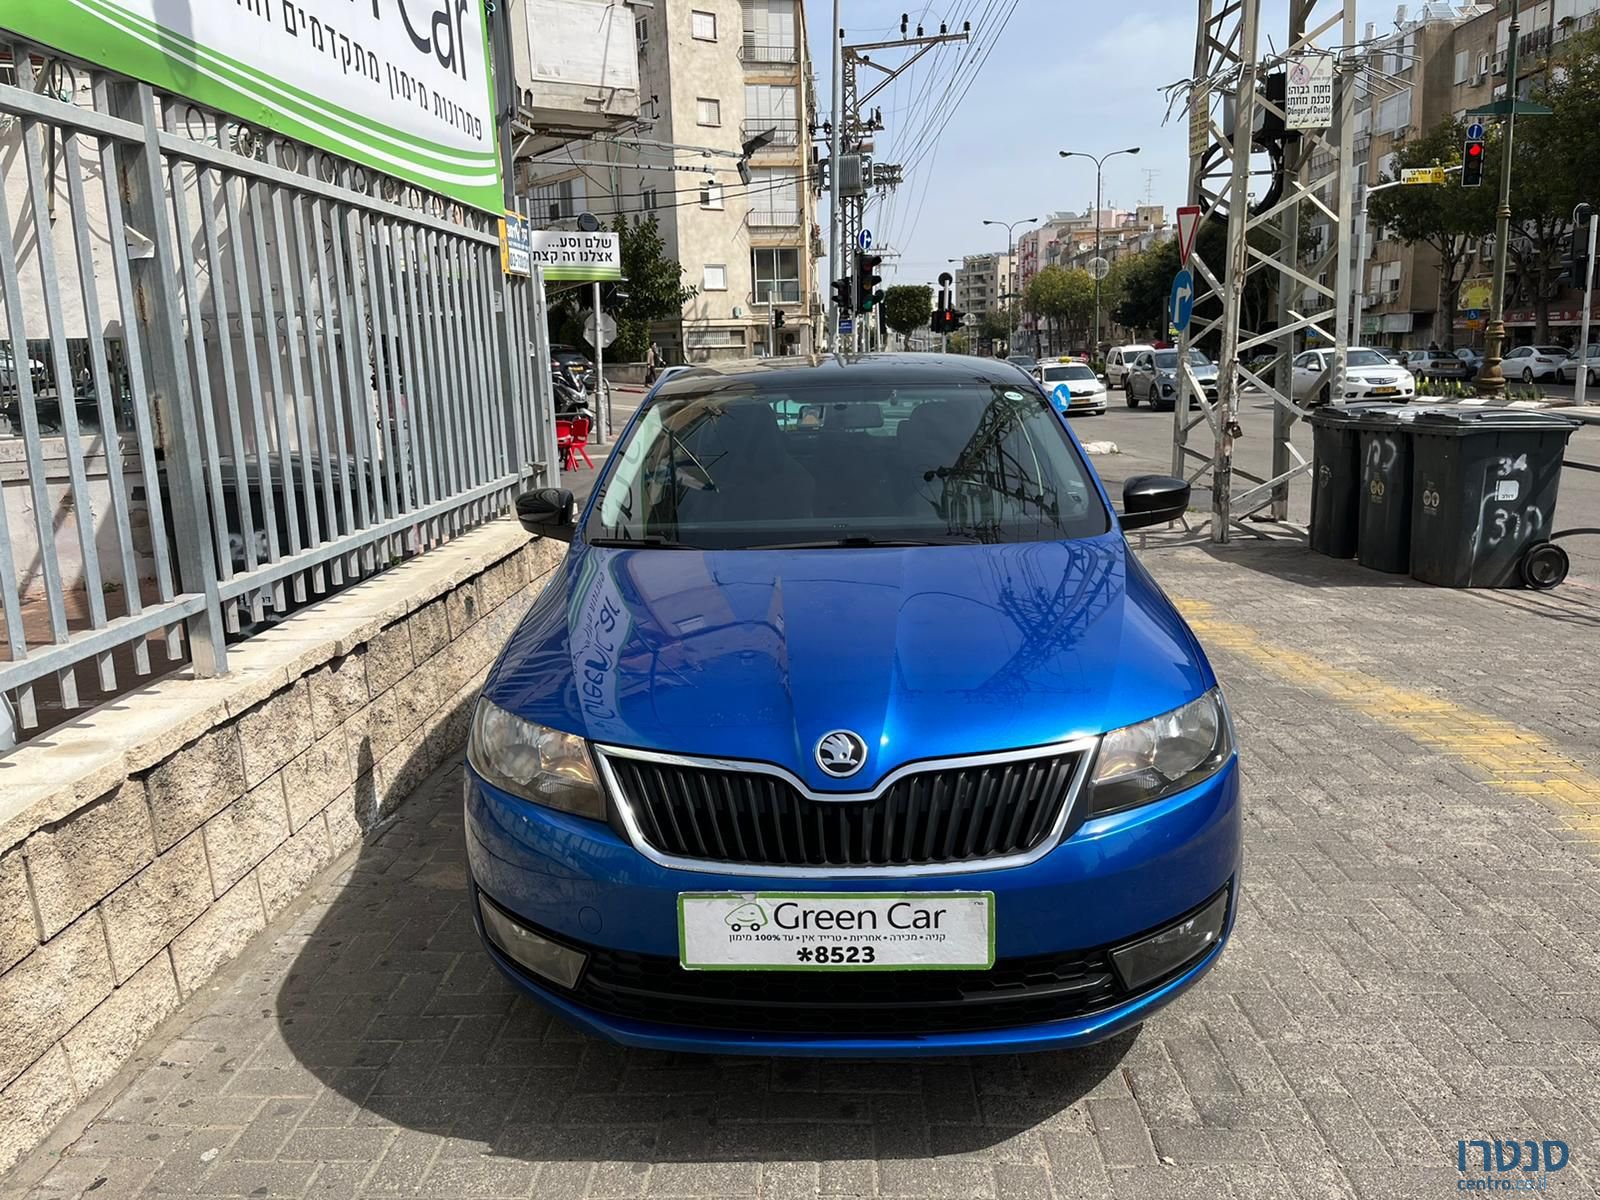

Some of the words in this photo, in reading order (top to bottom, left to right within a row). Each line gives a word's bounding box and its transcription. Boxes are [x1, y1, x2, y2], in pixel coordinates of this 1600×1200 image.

[282, 0, 380, 83] מתקדמים
[386, 62, 428, 110] מימון
[1311, 96, 1331, 104] סכנת
[433, 91, 481, 140] פתרונות
[547, 237, 581, 248] וסע...
[585, 236, 612, 249] שלם
[532, 251, 558, 264] קצת
[562, 251, 576, 261] זה
[579, 249, 613, 262] אצלנו
[1497, 453, 1527, 476] 34
[773, 902, 877, 930] Green
[887, 902, 947, 930] Car
[729, 934, 752, 943] מימון
[755, 934, 780, 942] 100%
[782, 934, 794, 942] עד
[802, 934, 816, 943] אין
[849, 934, 882, 942] אחריות
[889, 934, 918, 942] מכירה
[925, 934, 946, 942] קניה
